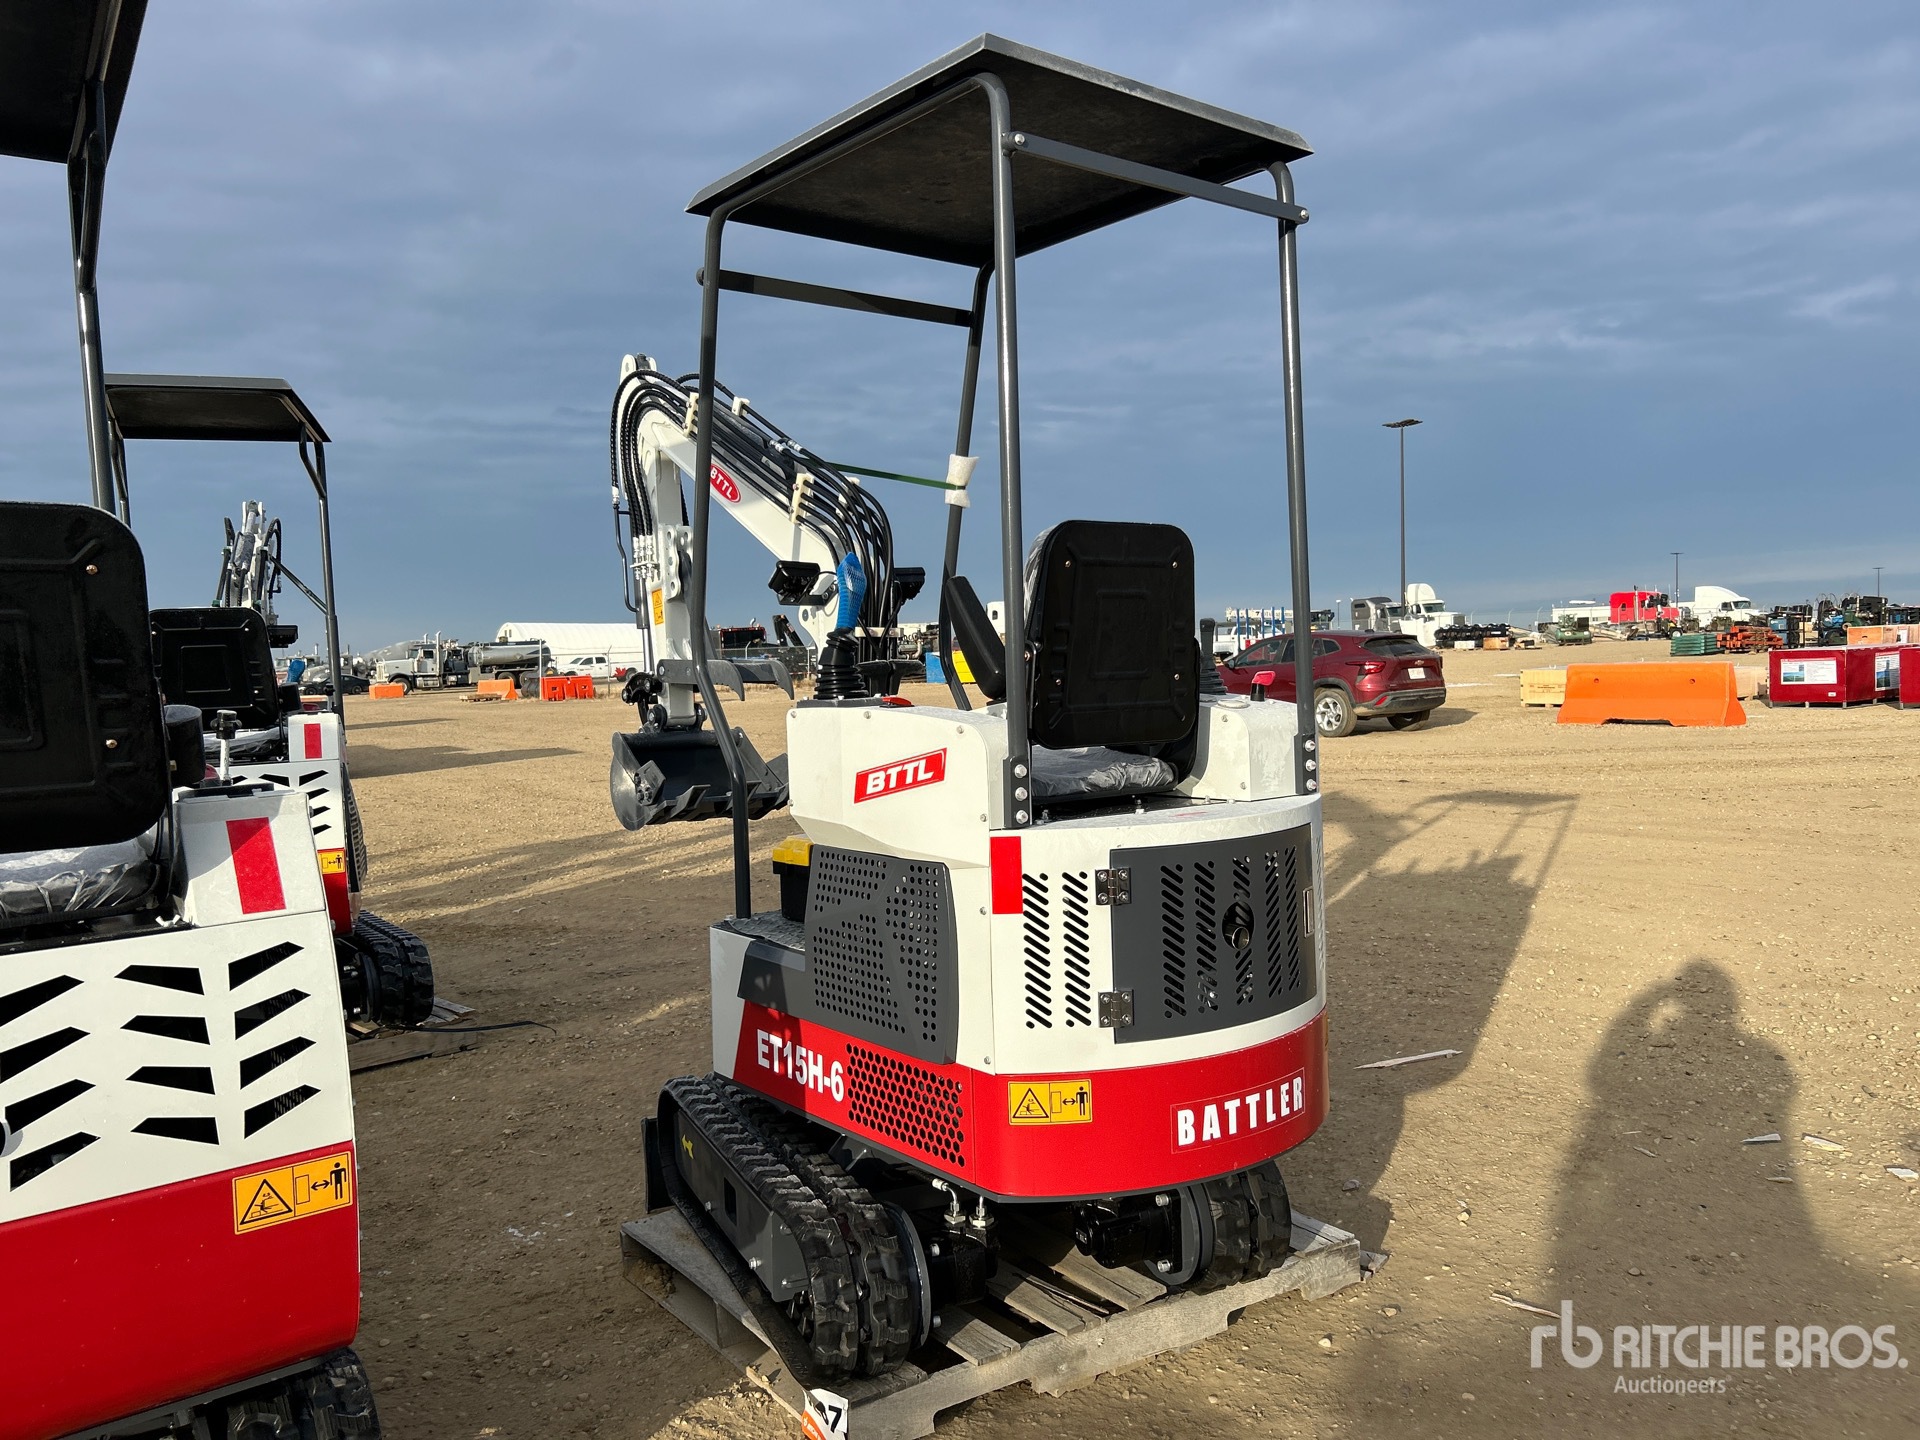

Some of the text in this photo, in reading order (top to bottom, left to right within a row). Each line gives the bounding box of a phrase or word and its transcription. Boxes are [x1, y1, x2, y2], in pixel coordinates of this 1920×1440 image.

[710, 467, 733, 499] BTTL
[866, 759, 935, 795] BTTL
[757, 1028, 845, 1103] ET15H-6
[1177, 1076, 1303, 1147] BATTLER
